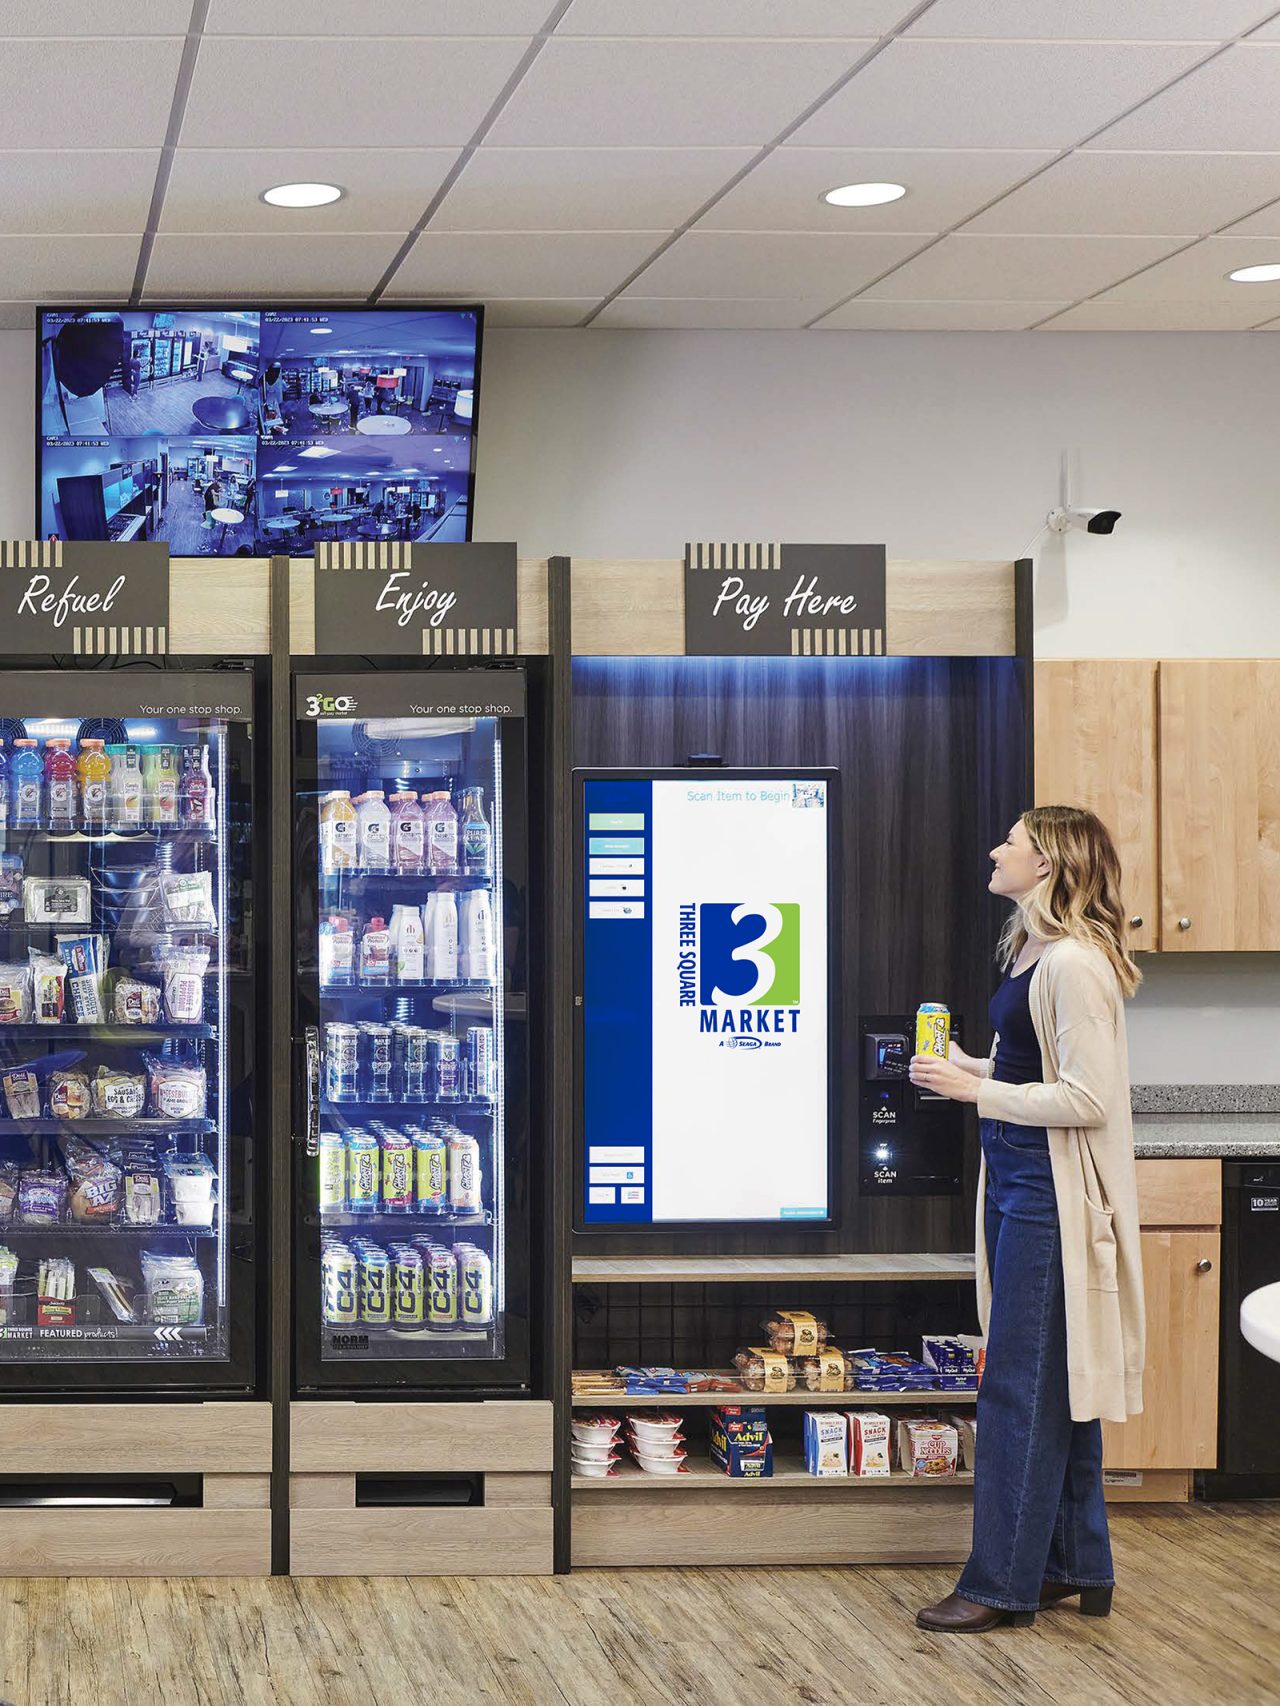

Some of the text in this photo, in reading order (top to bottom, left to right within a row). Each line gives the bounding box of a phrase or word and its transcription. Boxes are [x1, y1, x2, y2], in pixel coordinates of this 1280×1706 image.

[18, 575, 125, 628] Refuel
[376, 572, 456, 626] Enjoy
[712, 574, 856, 631] Pay Here
[140, 705, 164, 715] Your
[188, 706, 212, 716] stop
[215, 704, 242, 716] shop.
[410, 704, 512, 716] Your one stop shop.
[688, 791, 790, 804] Scan Item to Begin
[676, 903, 696, 1007] THREE SQUARE
[711, 902, 784, 1006] 3
[72, 982, 84, 1018] CHEESE
[700, 1010, 800, 1032] MARKET
[86, 1182, 117, 1198] BIG
[92, 1192, 113, 1206] AZ
[337, 1270, 354, 1313] C4
[368, 1270, 384, 1313] C4
[398, 1270, 416, 1313] C4
[433, 1270, 450, 1313] C4
[465, 1270, 482, 1313] C4
[40, 1328, 118, 1339] FEATURED products!
[734, 1432, 764, 1441] Advil
[821, 1427, 843, 1436] SNACK
[920, 1447, 952, 1455] NOODLES
